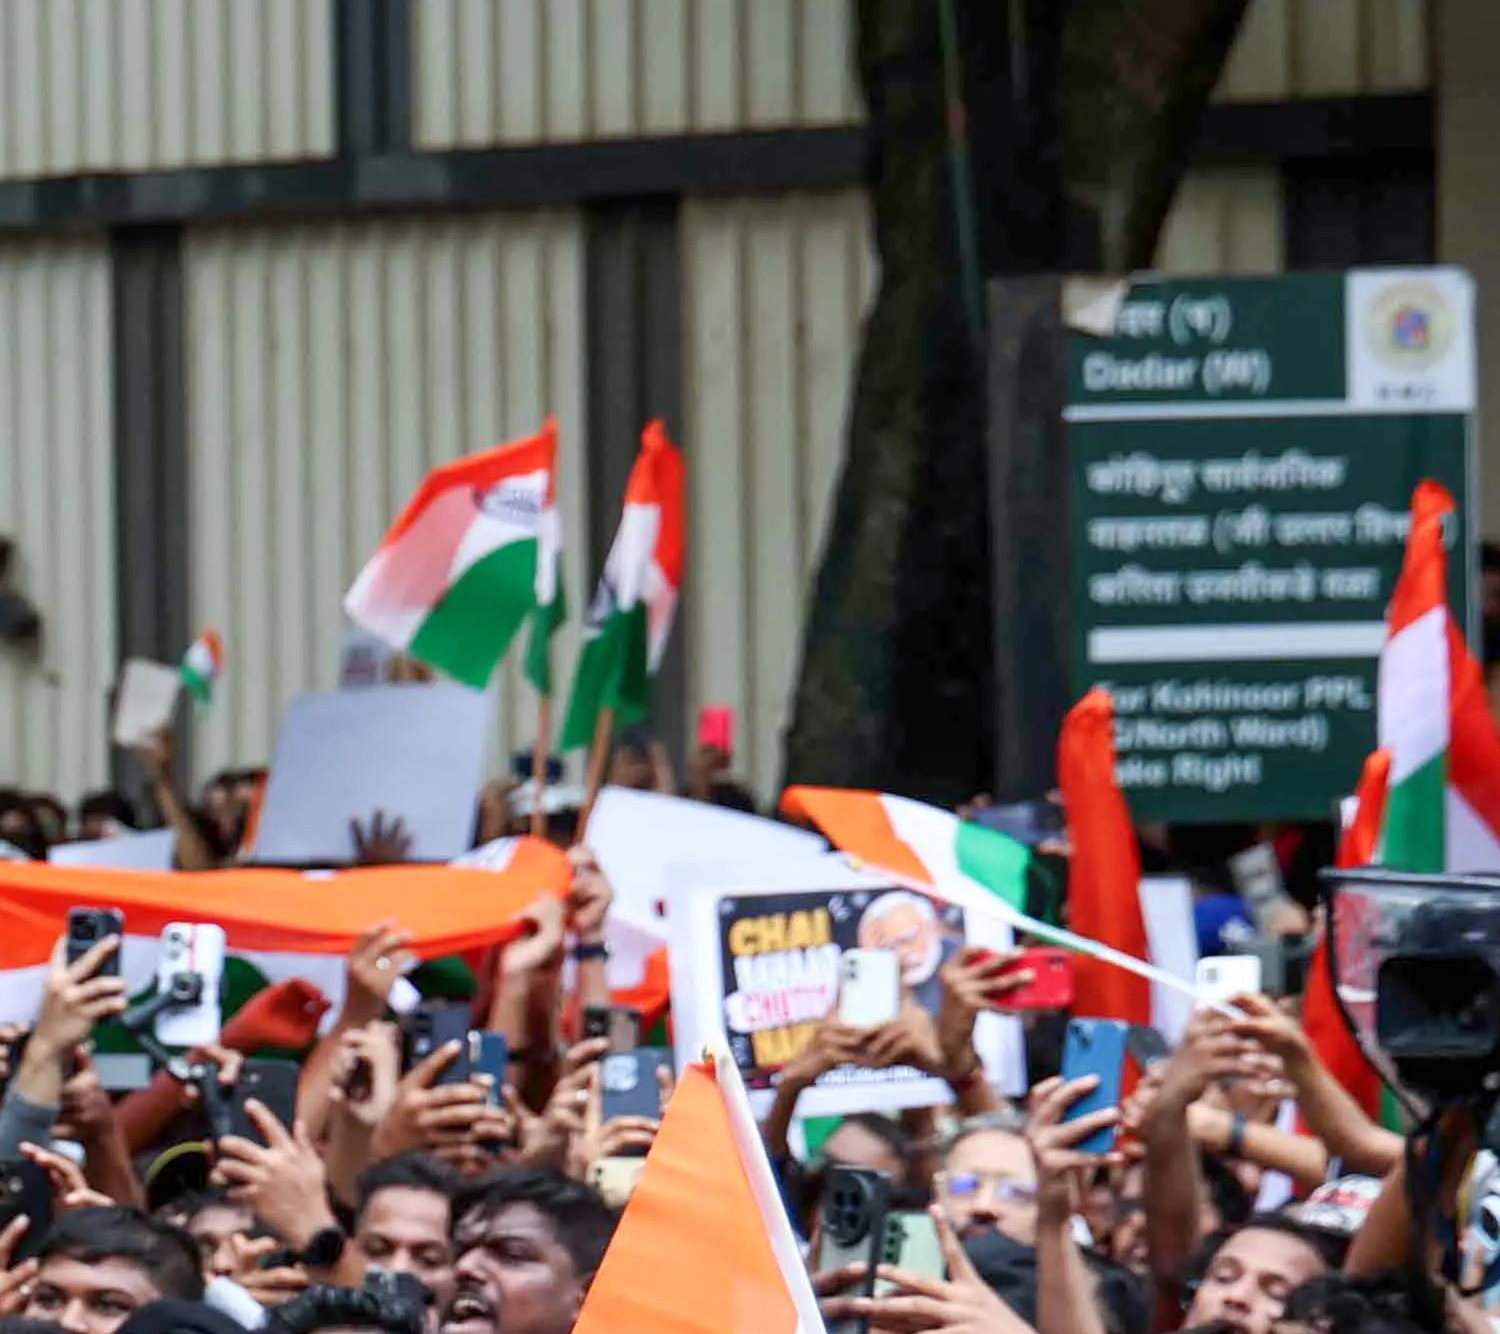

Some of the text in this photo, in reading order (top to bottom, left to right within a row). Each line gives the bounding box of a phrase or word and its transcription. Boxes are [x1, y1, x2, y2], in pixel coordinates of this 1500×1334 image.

[1106, 680, 1145, 713] or
[1152, 677, 1298, 714] Kohinoor
[1114, 753, 1263, 792] ake Right
[728, 906, 833, 957] CHAI
